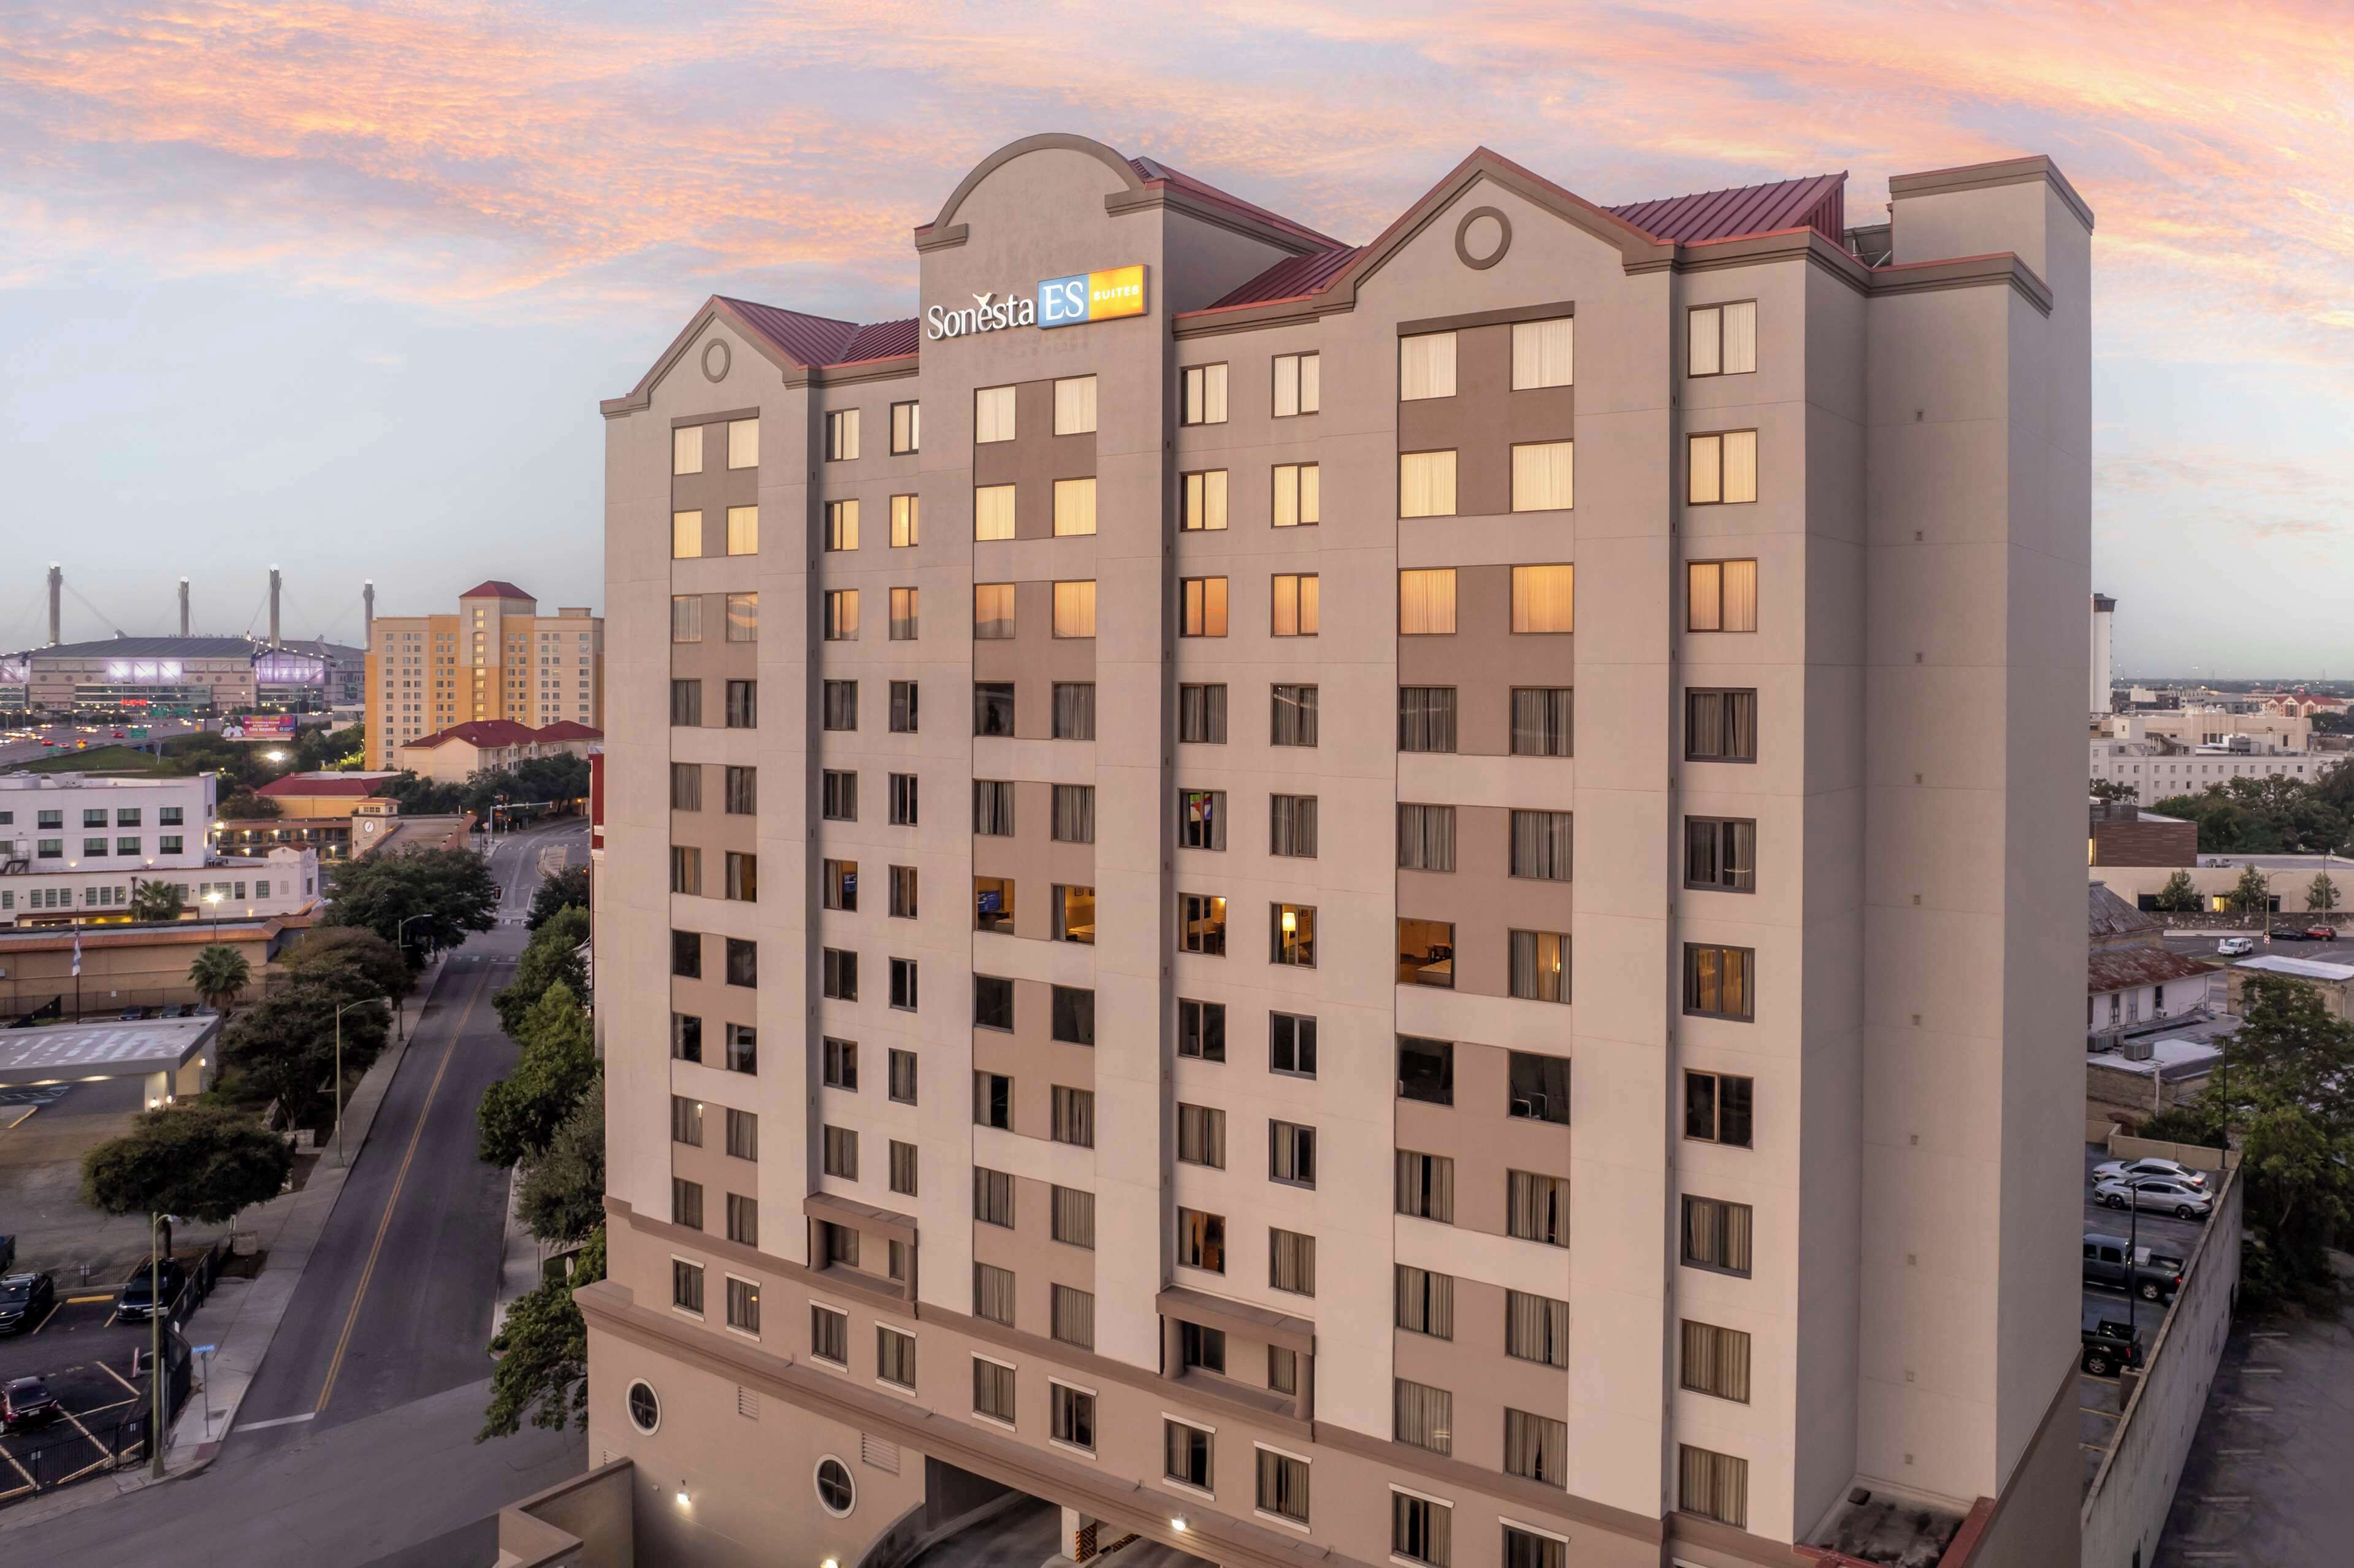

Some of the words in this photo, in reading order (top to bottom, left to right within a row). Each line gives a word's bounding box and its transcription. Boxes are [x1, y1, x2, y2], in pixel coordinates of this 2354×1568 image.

[928, 293, 1034, 339] Sonesta
[1043, 281, 1083, 321] ES
[1094, 285, 1139, 300] SUITES
